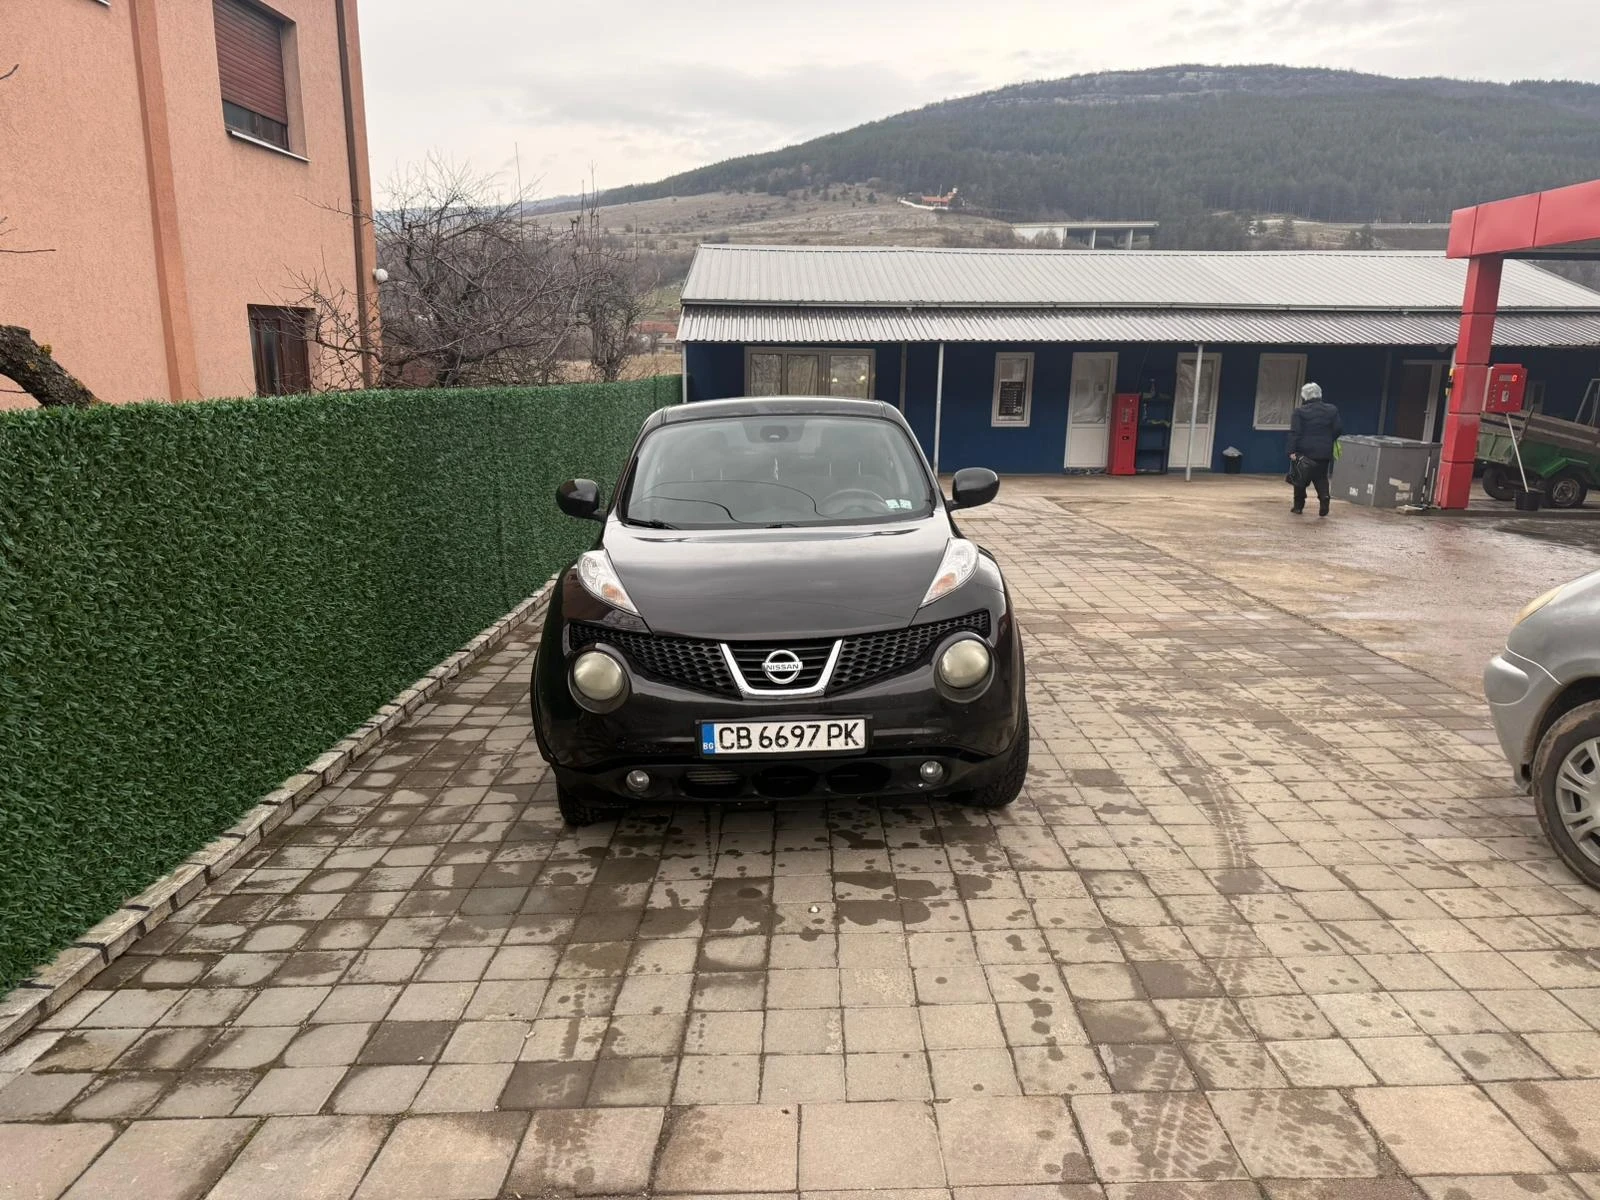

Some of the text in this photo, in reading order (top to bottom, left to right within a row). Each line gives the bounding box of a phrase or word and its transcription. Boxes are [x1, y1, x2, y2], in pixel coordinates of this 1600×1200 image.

[766, 663, 799, 671] NISSAN
[718, 722, 860, 750] CB 6697 PK
[702, 742, 715, 750] BG
